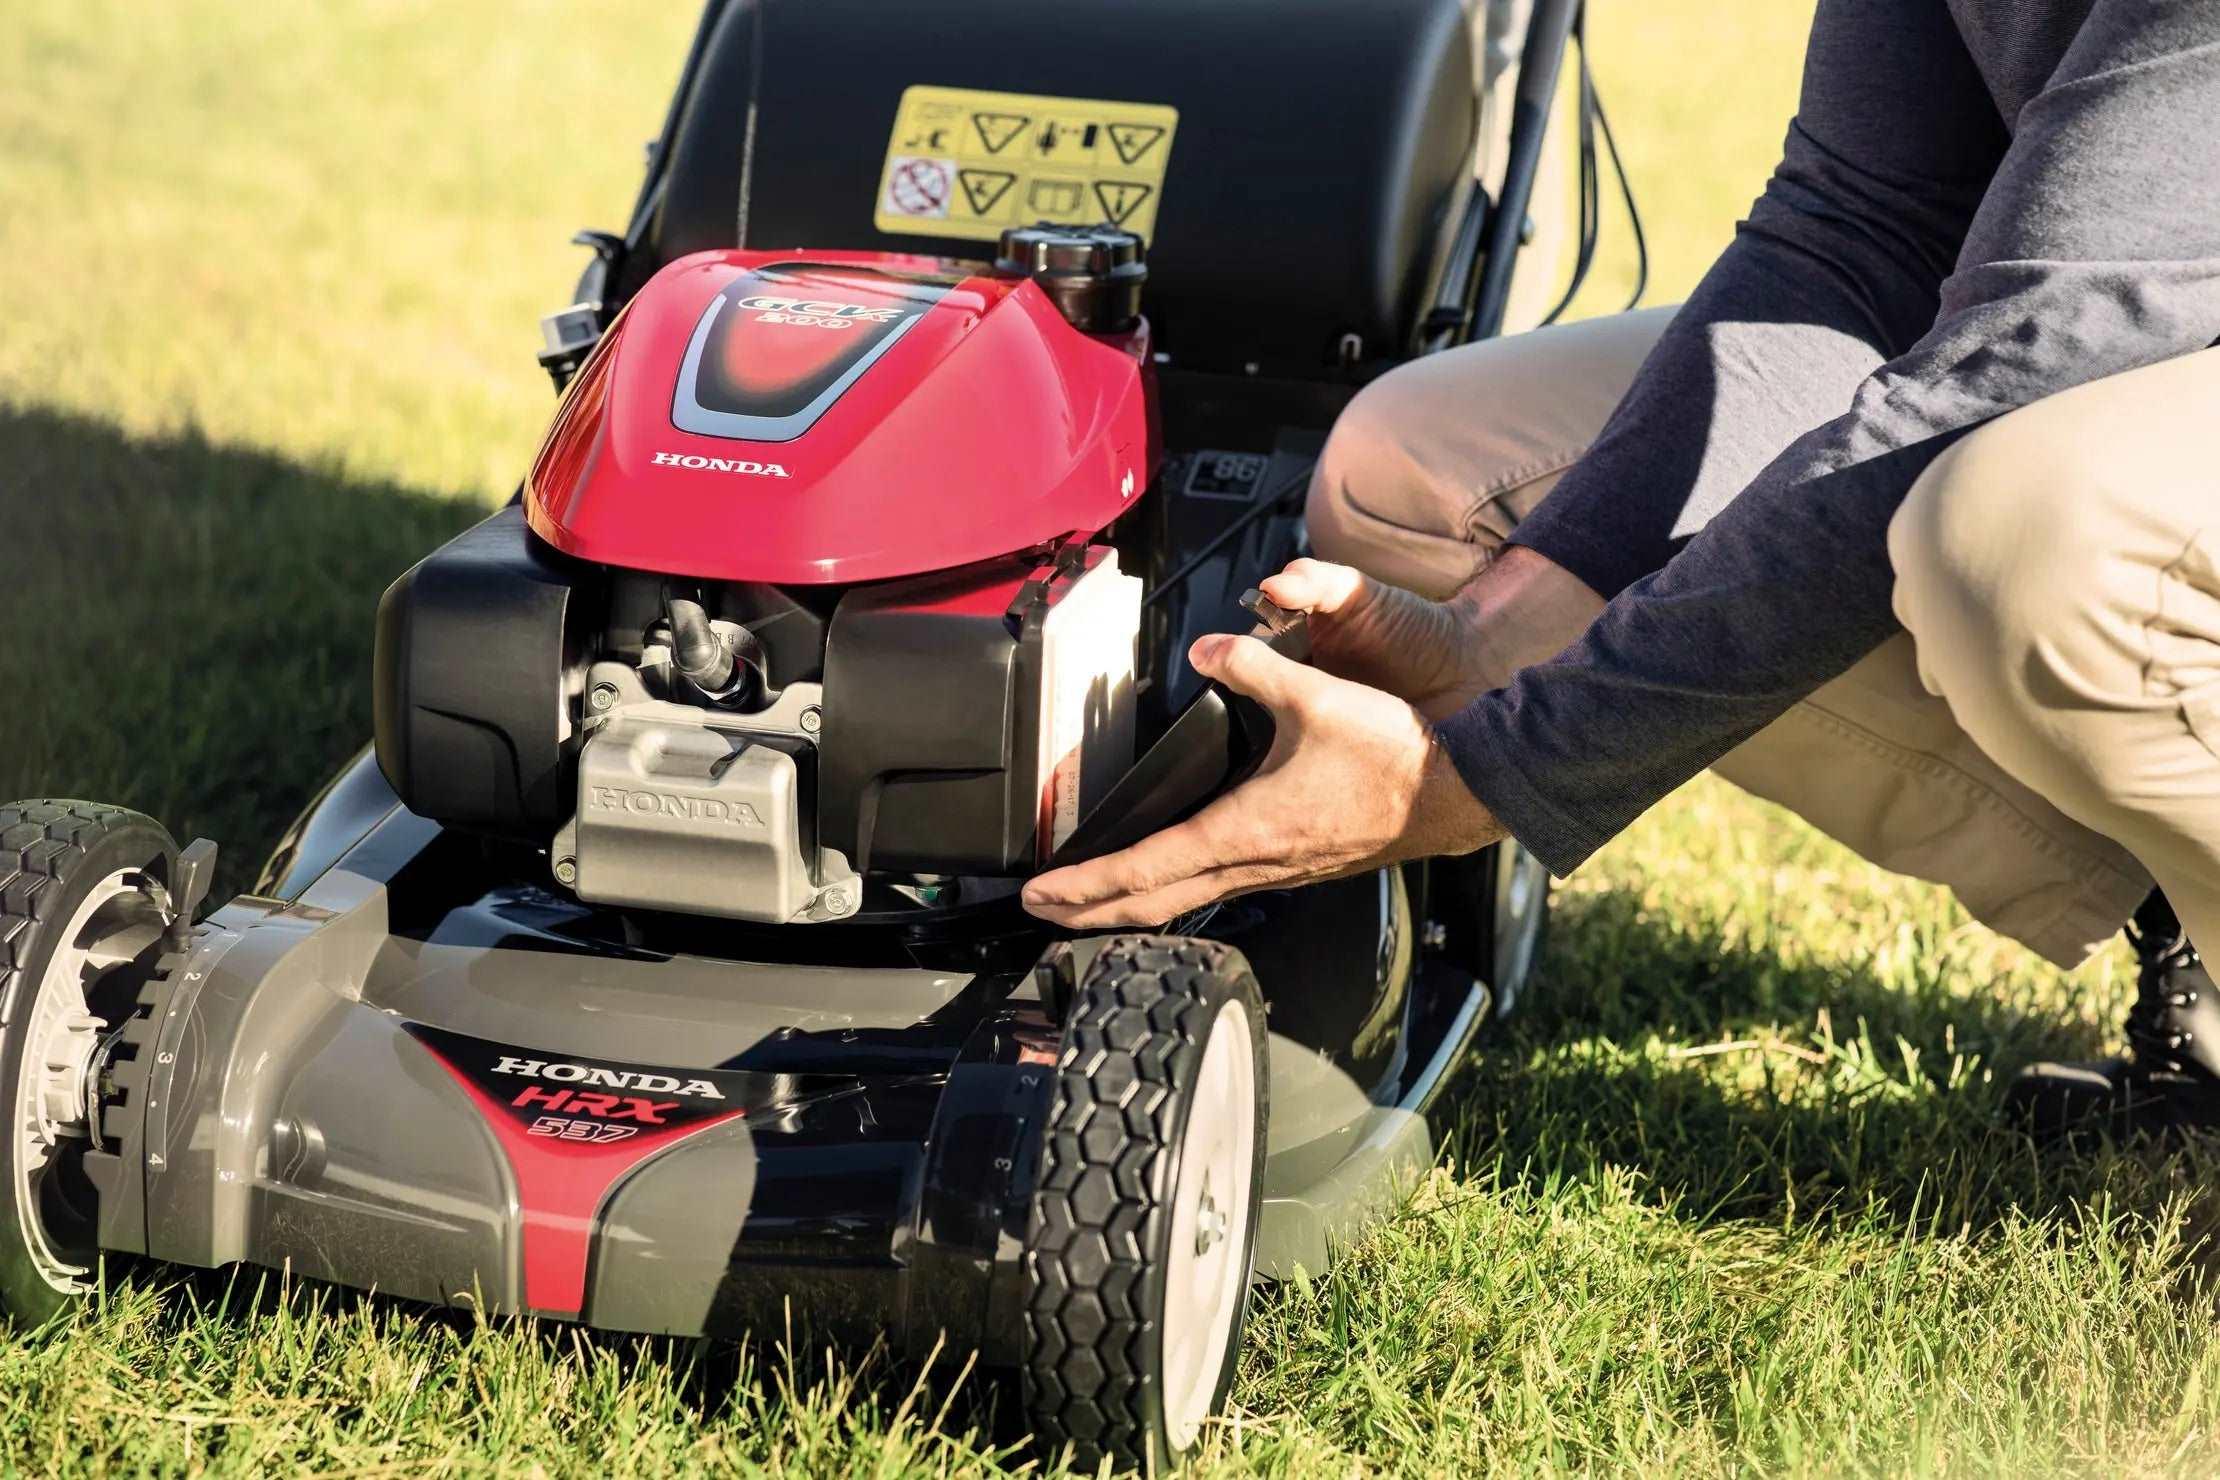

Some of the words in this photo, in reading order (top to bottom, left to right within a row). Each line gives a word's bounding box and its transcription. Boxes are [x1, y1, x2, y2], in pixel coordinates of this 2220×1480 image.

[755, 312, 853, 329] 200
[651, 452, 789, 477] HONDA
[590, 786, 765, 827] HONDA
[184, 972, 201, 981] 2
[158, 1052, 173, 1065] 3
[490, 1056, 726, 1100] HONDA
[1022, 1075, 1039, 1087] 2
[512, 1086, 681, 1124] HRX
[528, 1116, 638, 1143] 537
[149, 1153, 163, 1166] 4
[995, 1158, 1012, 1171] 3
